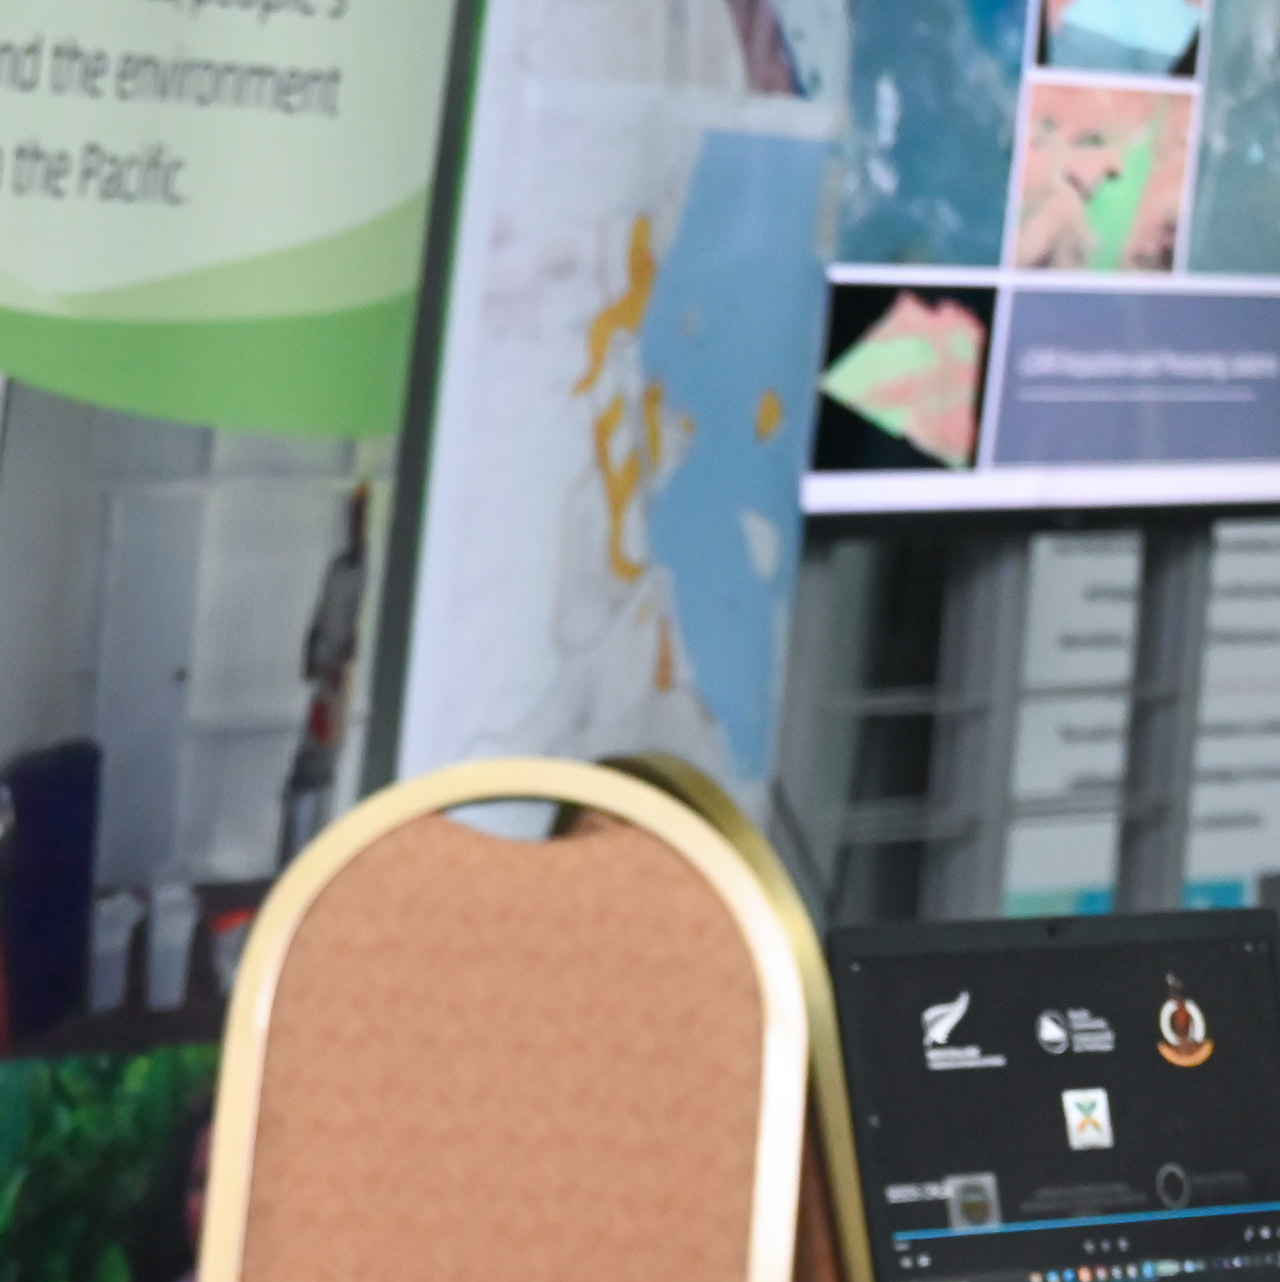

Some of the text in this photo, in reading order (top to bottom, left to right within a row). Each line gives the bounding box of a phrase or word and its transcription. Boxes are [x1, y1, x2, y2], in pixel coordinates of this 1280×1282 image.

[50, 39, 109, 100] the
[114, 50, 342, 118] environment
[12, 139, 74, 199] the
